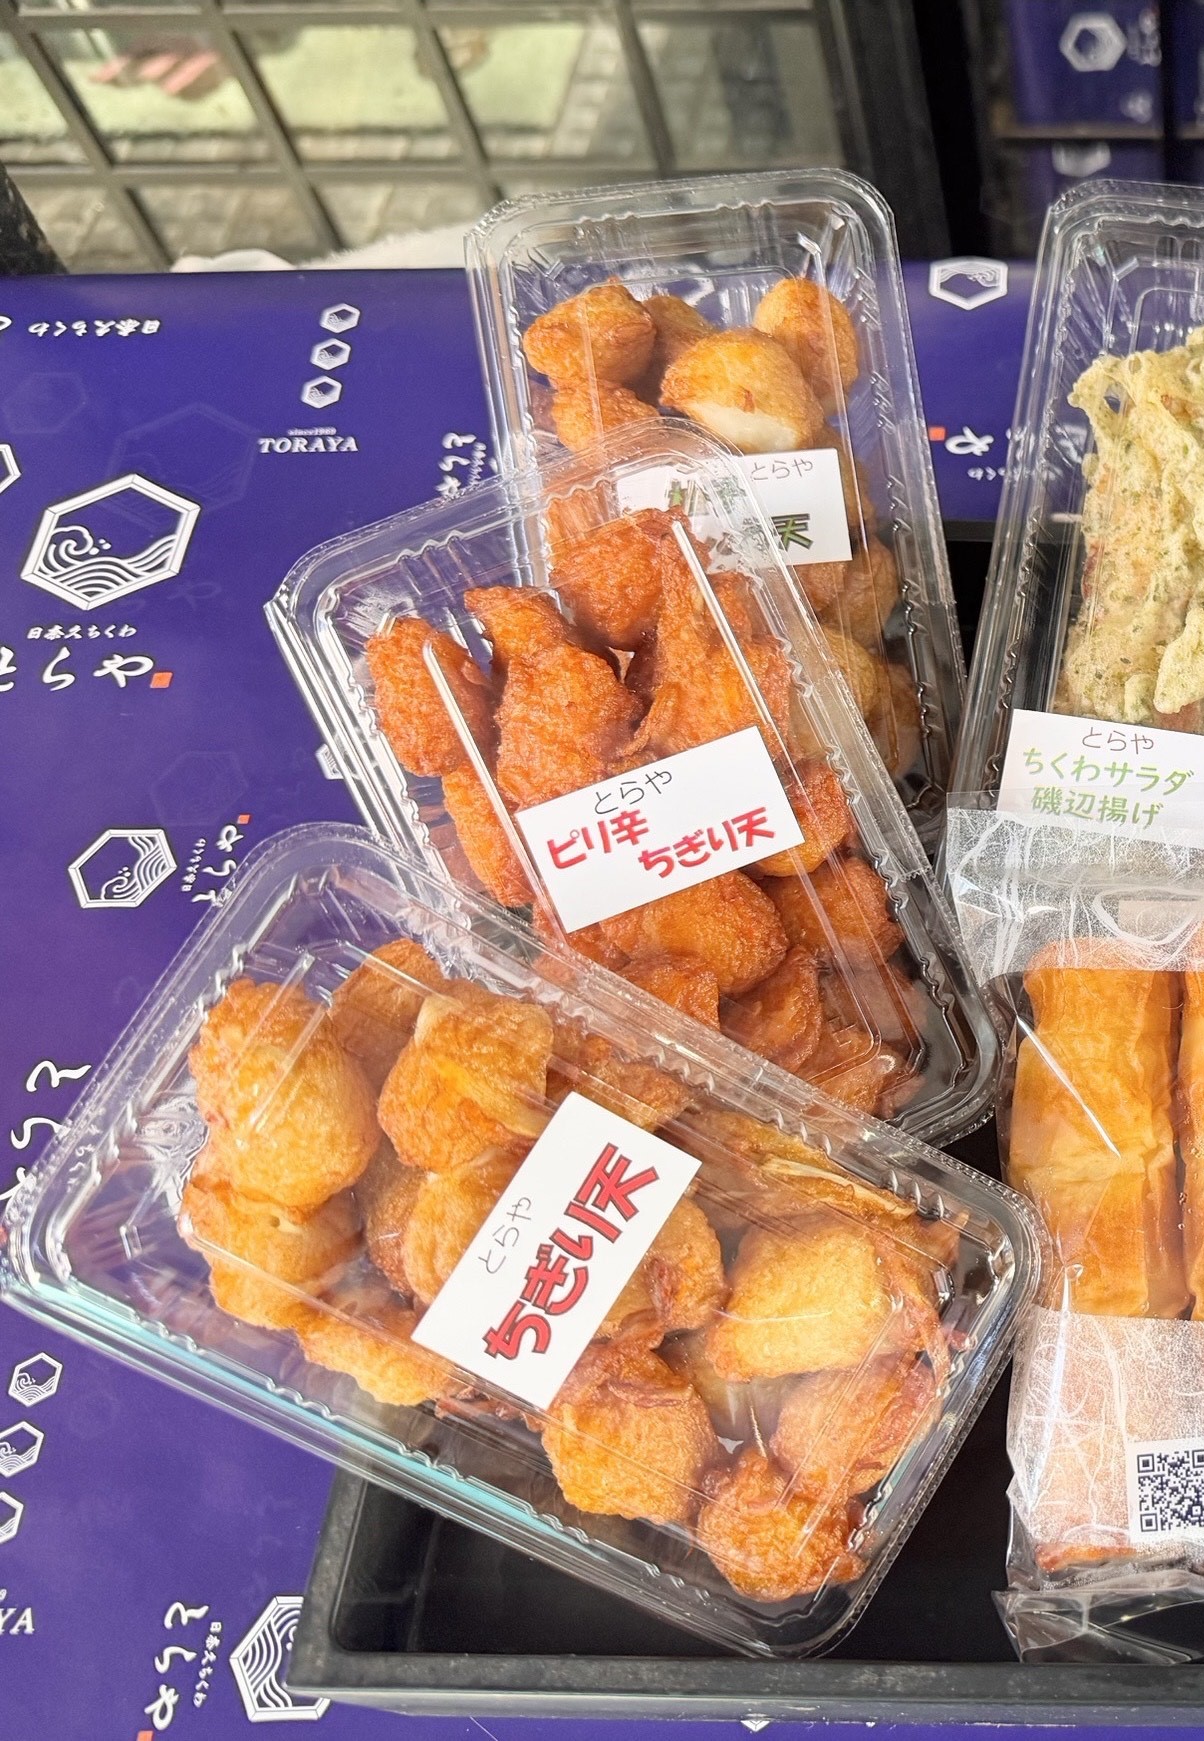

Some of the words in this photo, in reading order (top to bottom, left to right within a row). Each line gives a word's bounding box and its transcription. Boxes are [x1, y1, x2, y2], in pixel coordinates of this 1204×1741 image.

[28, 319, 162, 337] 日奈久ちくわ
[257, 436, 359, 453] TORAYA
[750, 458, 814, 482] とらや
[27, 624, 138, 640] 日奈久ちくわ
[1081, 726, 1155, 755] とらや
[594, 770, 673, 815] とらや
[1023, 747, 1195, 796] ちくわサラダ
[1030, 786, 1165, 830] 磯辺揚げ
[546, 808, 650, 870] ピリ辛
[637, 806, 777, 879] ちぎり天
[478, 1196, 533, 1275] とらや
[482, 1142, 660, 1361] ちぎり天
[144, 1601, 209, 1731] とらや
